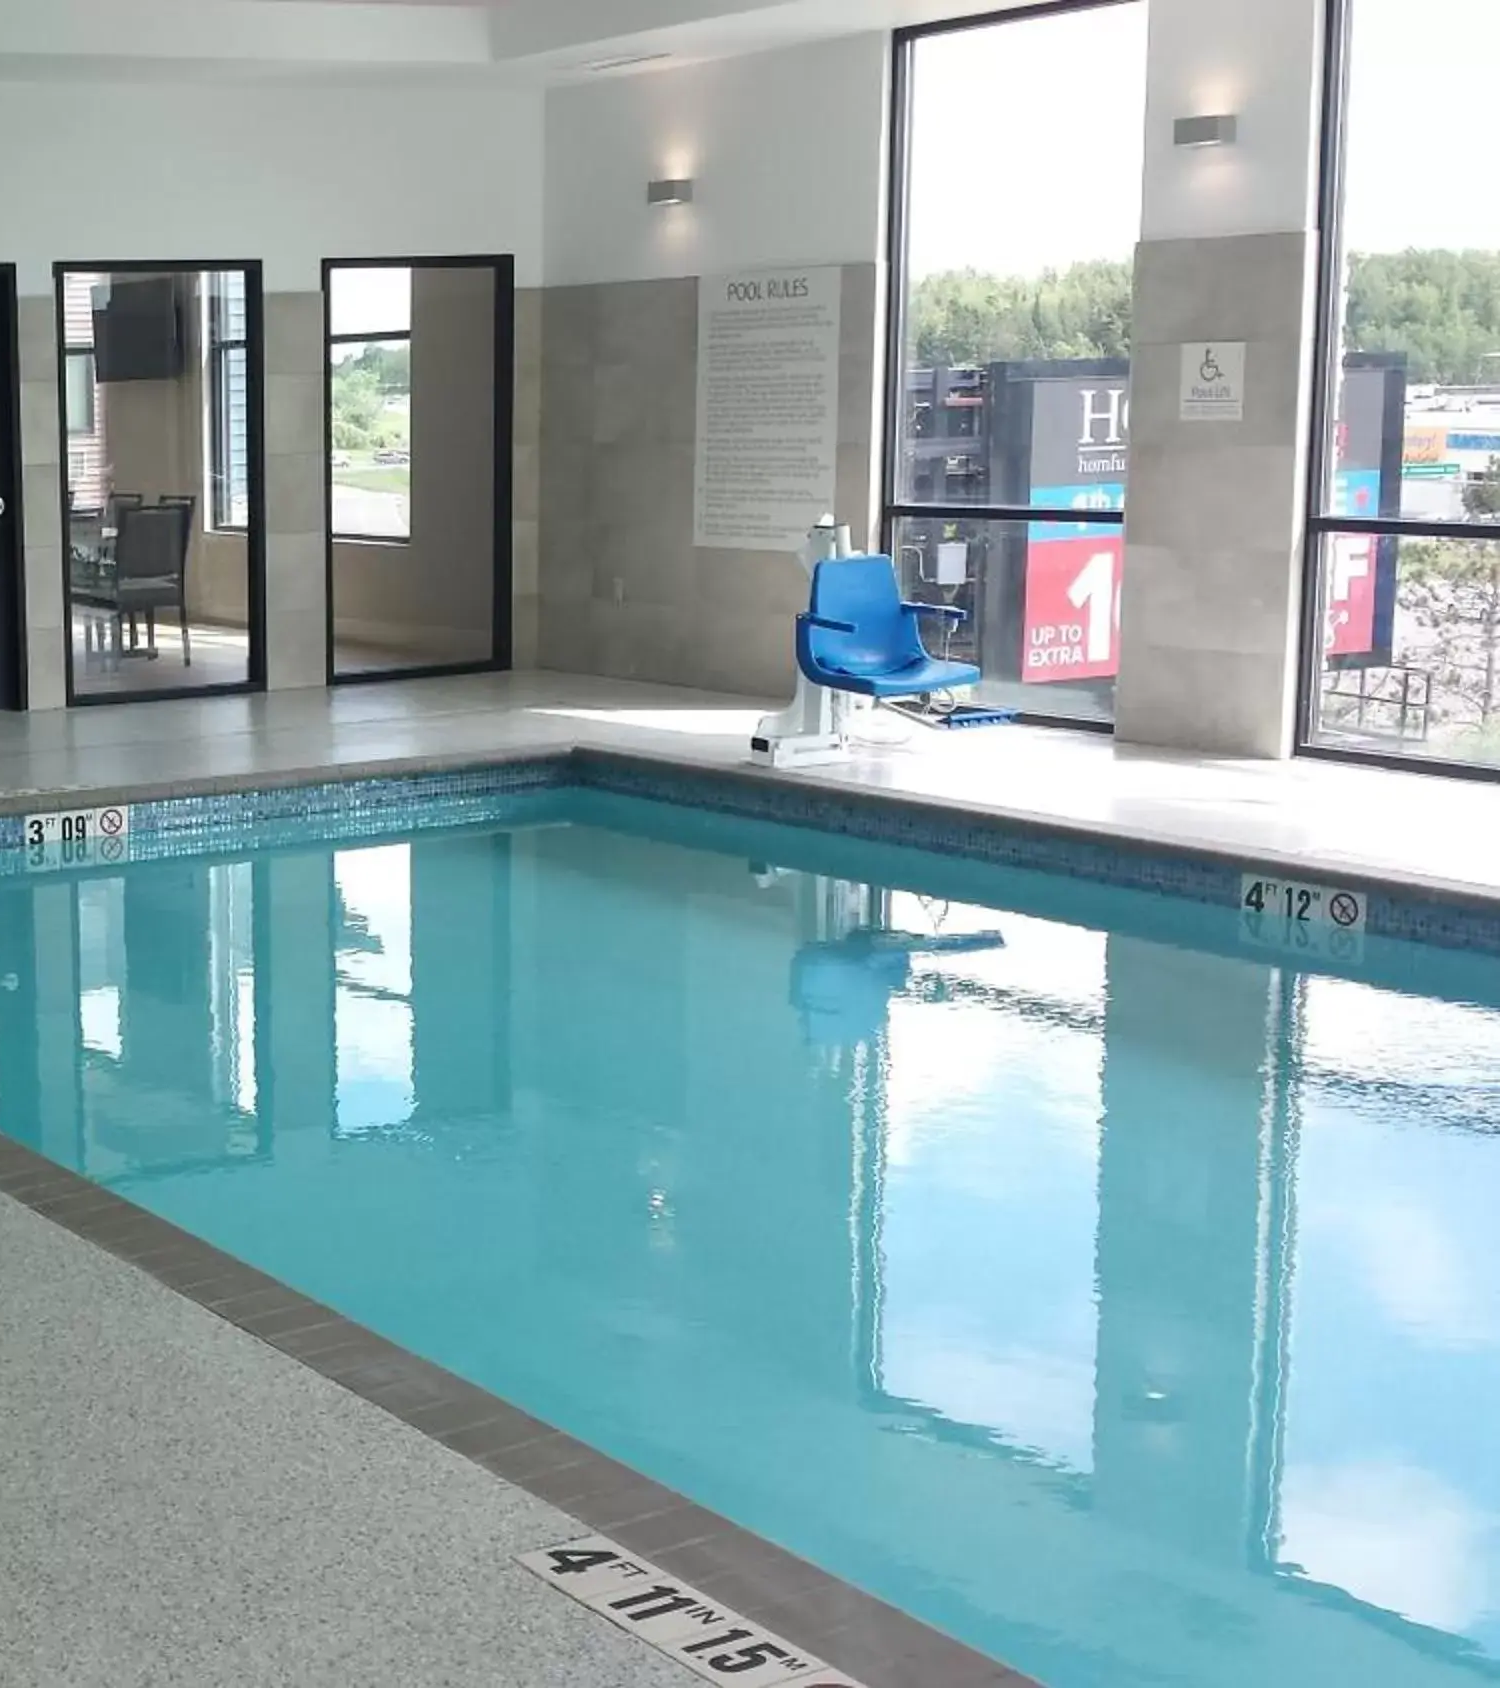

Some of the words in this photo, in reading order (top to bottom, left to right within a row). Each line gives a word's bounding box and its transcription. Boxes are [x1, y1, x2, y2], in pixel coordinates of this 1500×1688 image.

[727, 281, 763, 300] POOL
[767, 278, 808, 298] RULES
[1078, 389, 1129, 443] H
[1032, 628, 1055, 645] UP
[1058, 625, 1082, 643] TO
[1028, 645, 1084, 666] EXTRA
[28, 819, 45, 845] 3
[1245, 881, 1265, 913] 4
[546, 1549, 620, 1575] 4
[609, 1561, 648, 1578] FT
[608, 1584, 699, 1622] 11
[686, 1605, 725, 1626] IN
[779, 1657, 808, 1671] M
